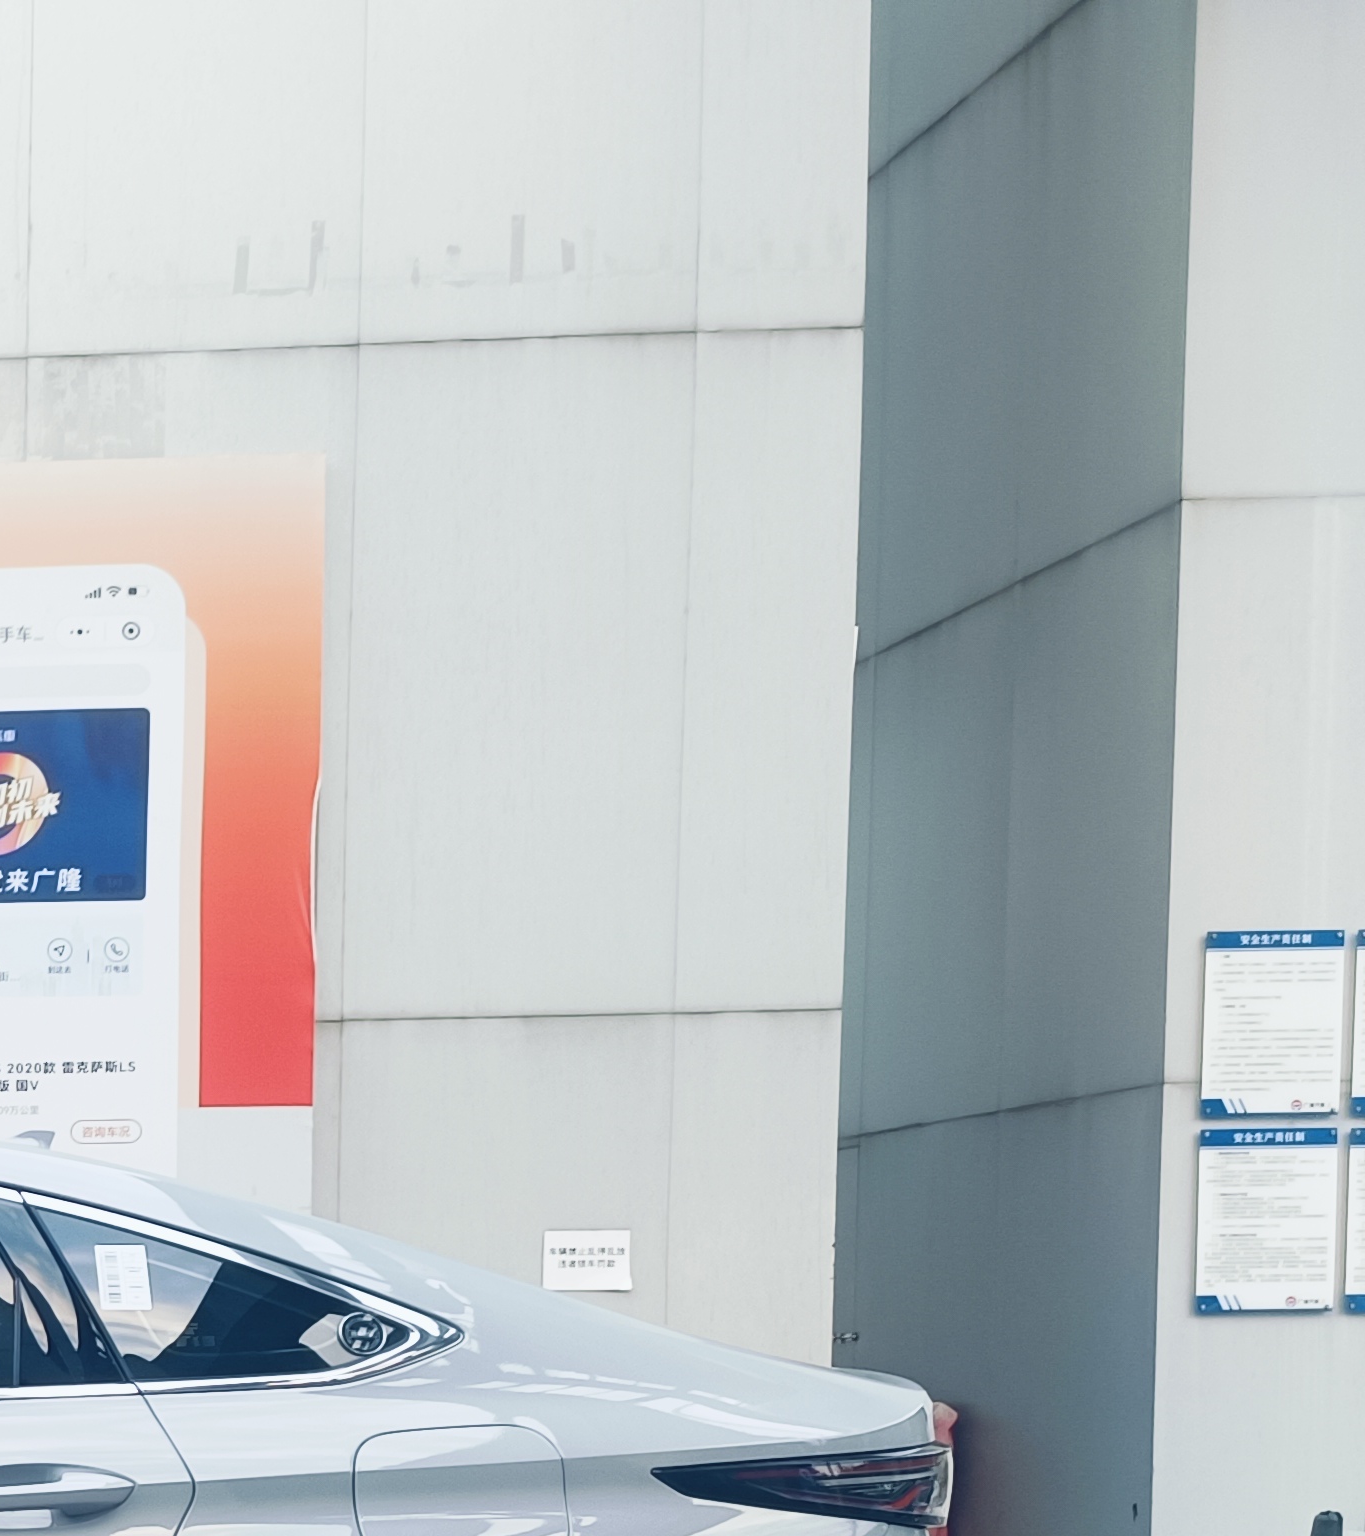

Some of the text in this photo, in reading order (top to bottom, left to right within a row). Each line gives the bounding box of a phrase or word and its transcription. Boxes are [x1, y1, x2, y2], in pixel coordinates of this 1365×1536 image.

[7, 1061, 56, 1074] 2020款
[62, 1061, 136, 1074] 雷克萨斯LS
[82, 1126, 131, 1138] 咨询车况
